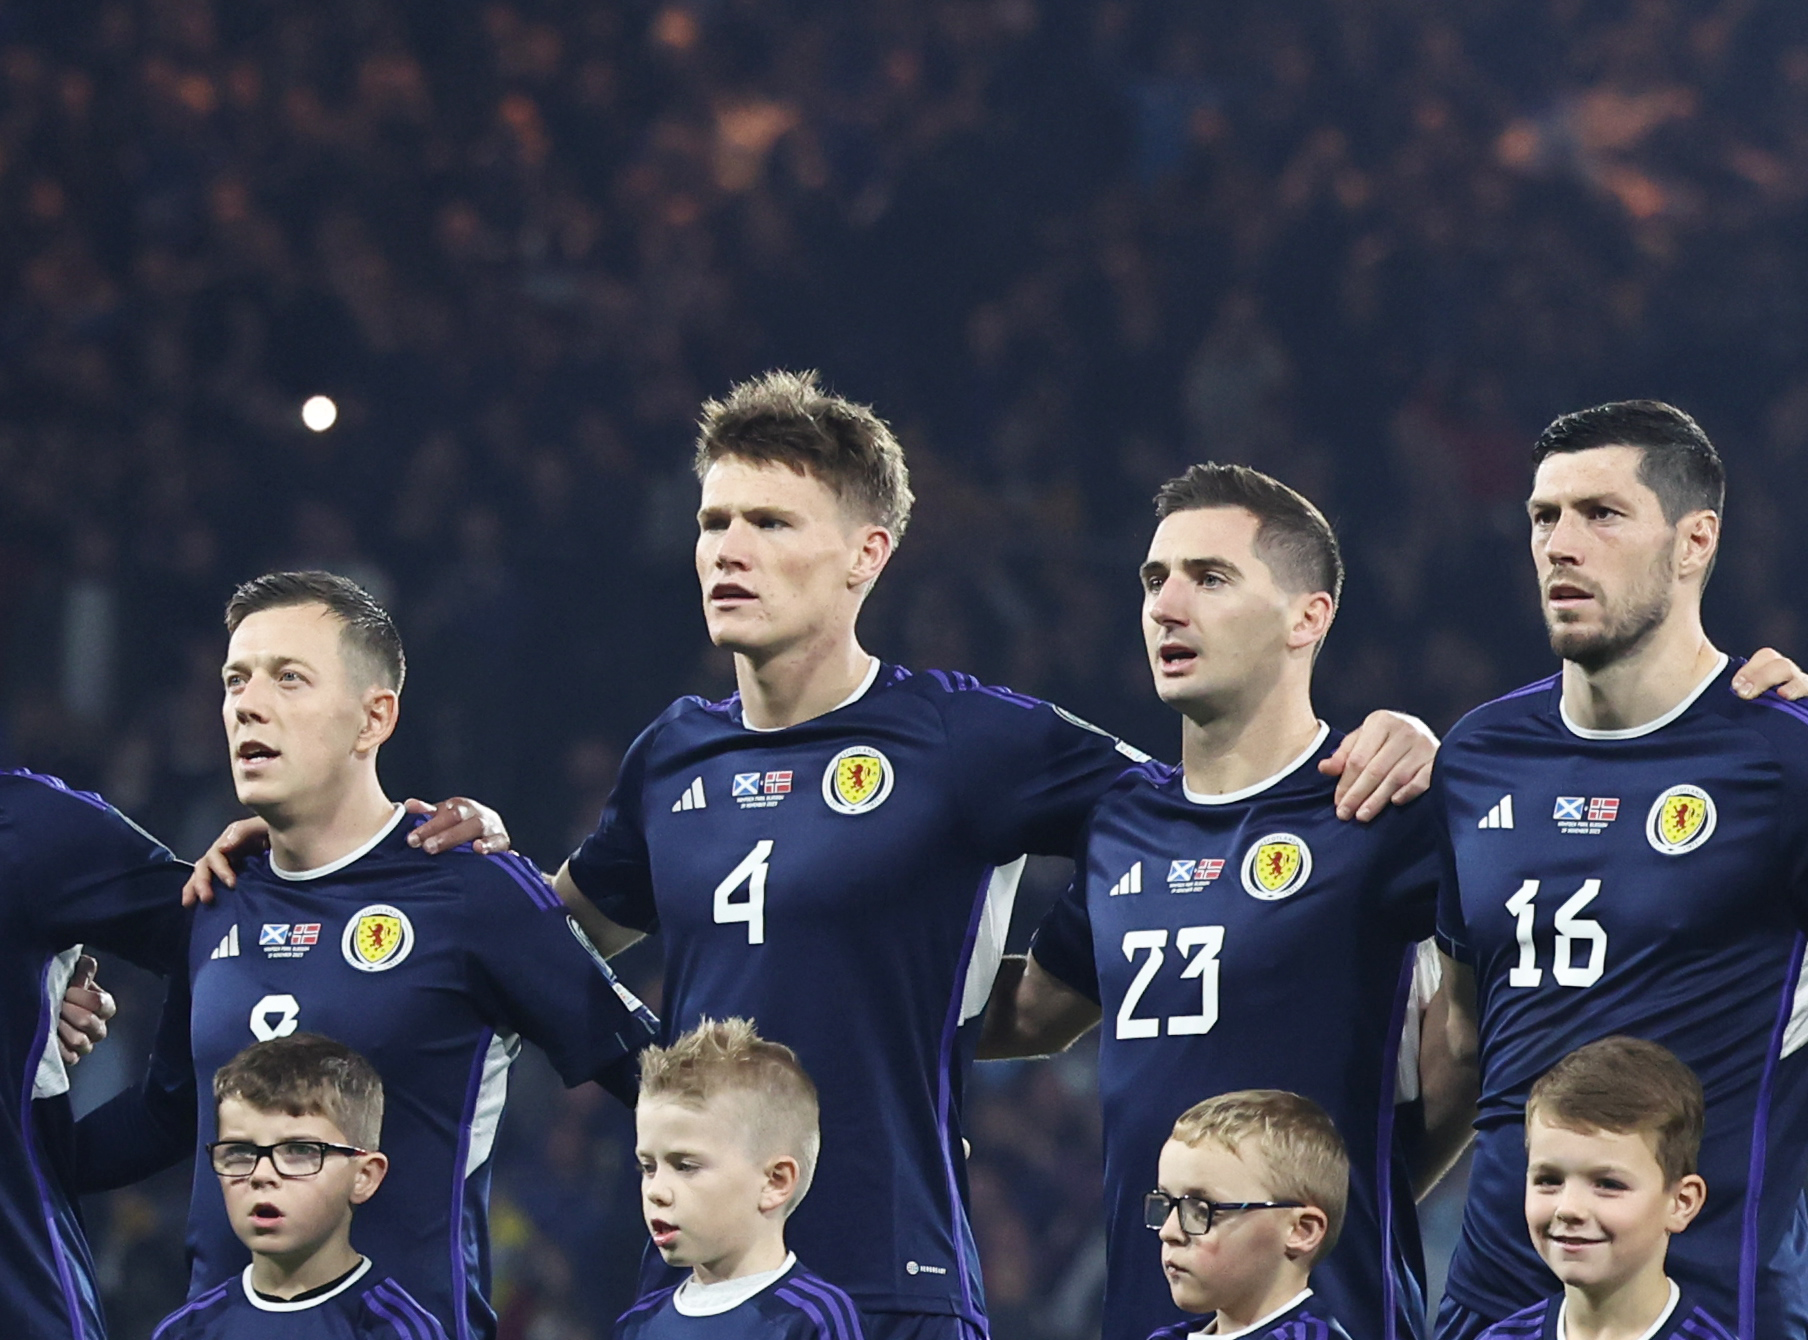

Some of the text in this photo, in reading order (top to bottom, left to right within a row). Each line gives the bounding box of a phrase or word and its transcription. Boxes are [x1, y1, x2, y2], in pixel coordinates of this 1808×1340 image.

[713, 840, 774, 944] 4
[1505, 879, 1607, 987] 16
[1116, 925, 1225, 1039] 23
